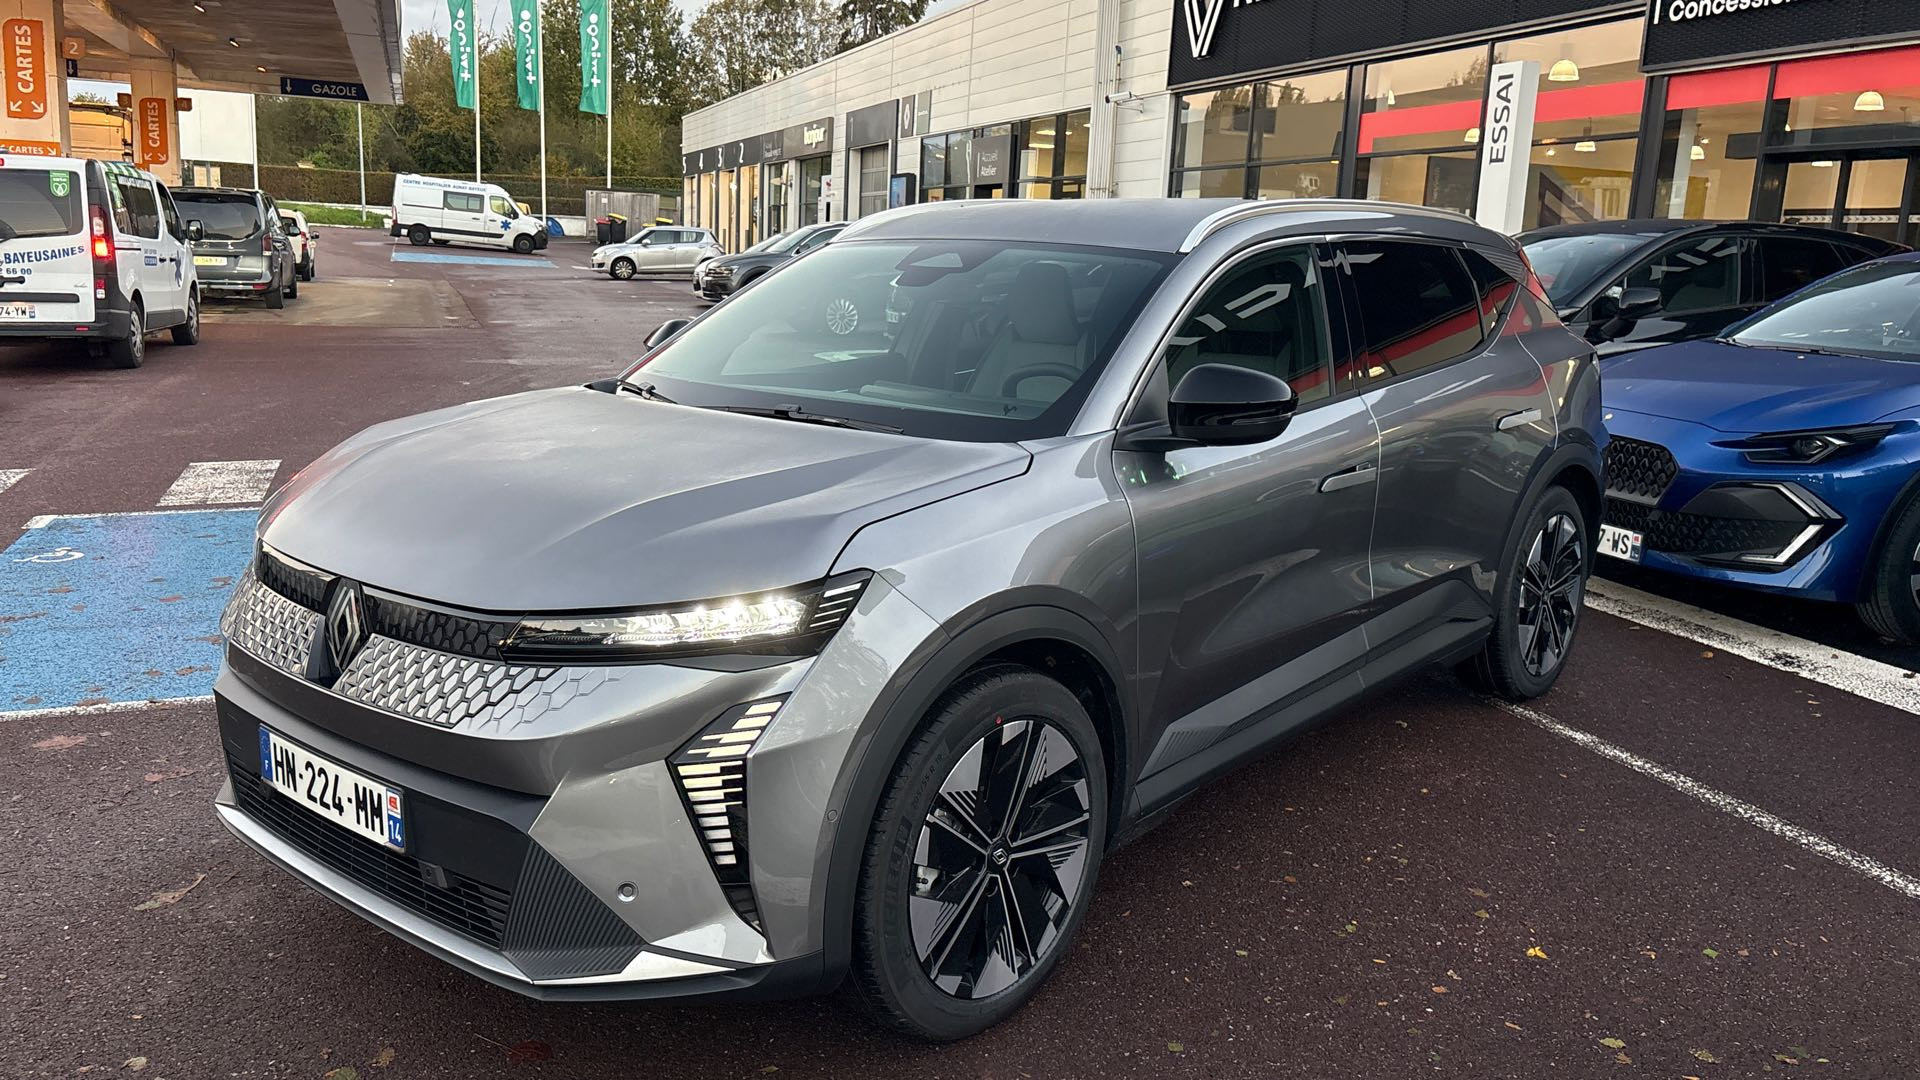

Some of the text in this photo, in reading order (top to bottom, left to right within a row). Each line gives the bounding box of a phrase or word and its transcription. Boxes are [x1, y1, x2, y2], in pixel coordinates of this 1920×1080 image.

[14, 24, 35, 94] CARTES
[68, 42, 79, 55] 2
[311, 84, 357, 97] GAZOLE
[147, 101, 160, 148] CARTES
[1489, 73, 1514, 165] ESSAI
[8, 145, 44, 155] CARTES
[739, 142, 745, 164] 2
[3, 245, 85, 264] BAYEUSAINES
[6, 267, 18, 275] 66
[20, 267, 32, 275] 00
[272, 742, 385, 836] HN-224-MM
[389, 819, 402, 843] 14
